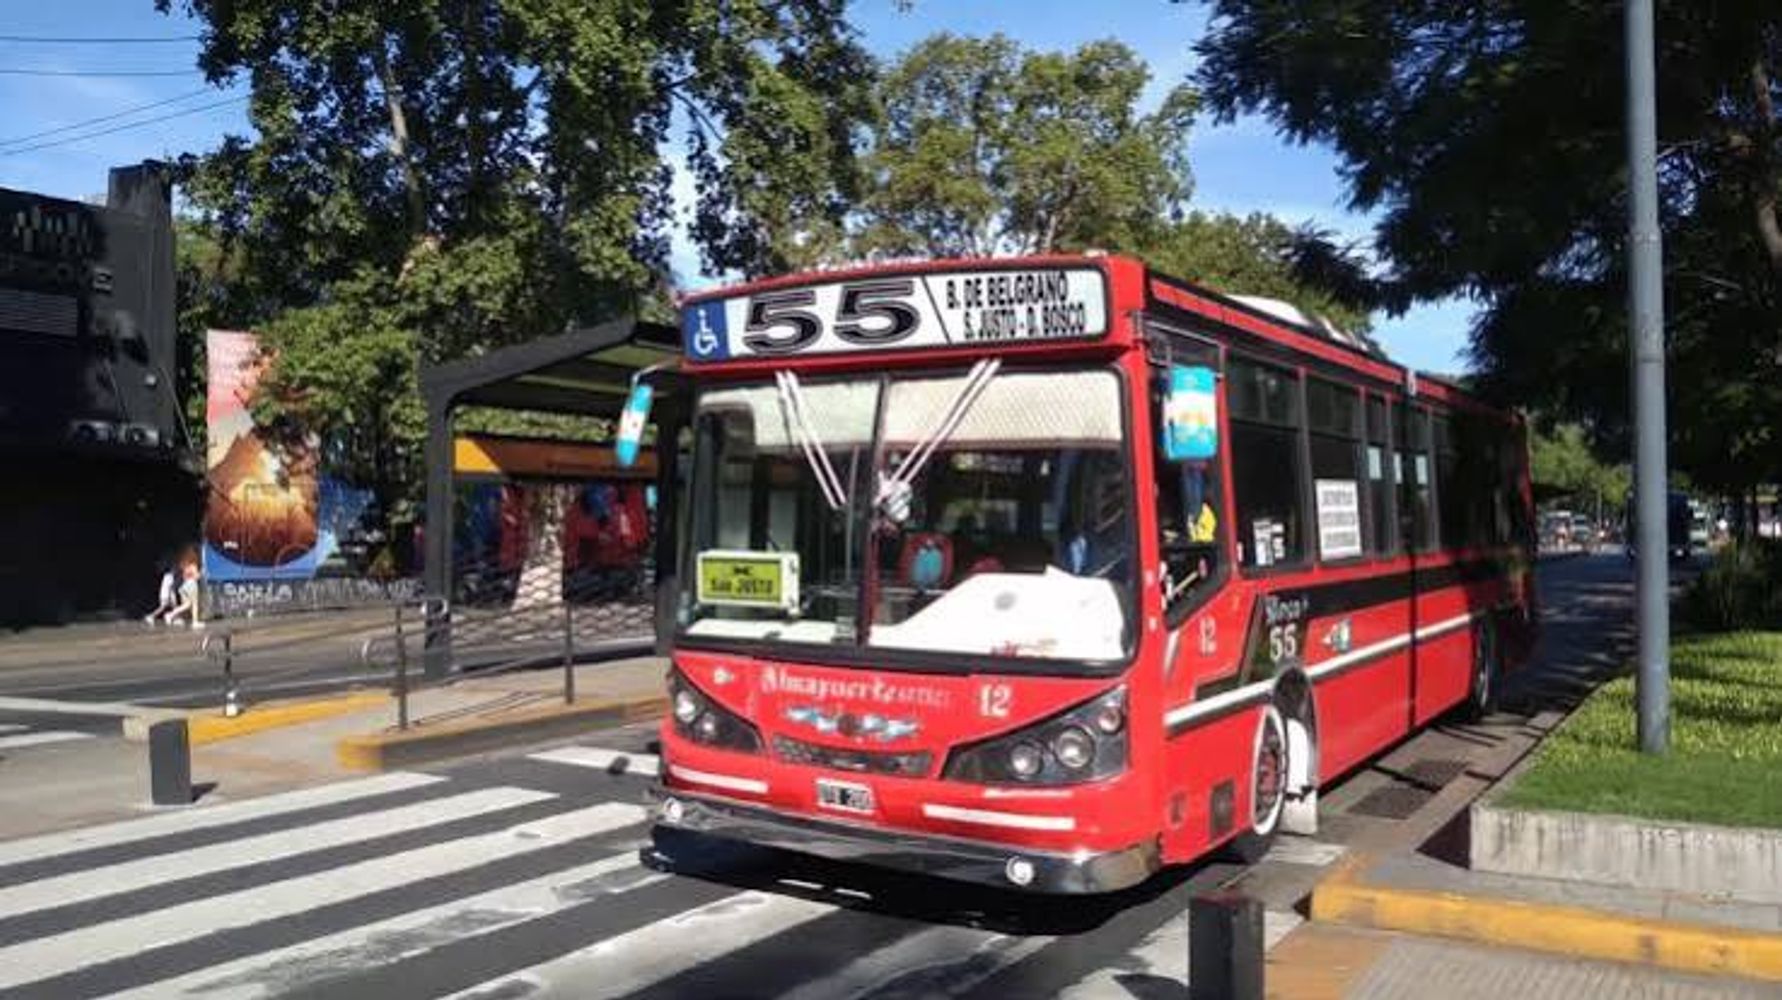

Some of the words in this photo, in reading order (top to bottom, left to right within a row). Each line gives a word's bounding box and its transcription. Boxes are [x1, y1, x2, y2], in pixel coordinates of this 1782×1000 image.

[946, 279, 960, 309] B.
[964, 278, 983, 308] DE
[987, 271, 1069, 306] BELGRANO
[742, 279, 921, 356] 55
[964, 311, 975, 339] S.
[979, 308, 1017, 339] JUSTO
[1043, 301, 1086, 335] BOSCO
[1199, 615, 1217, 656] 12
[1269, 622, 1297, 662] 55
[980, 682, 1013, 717] 12
